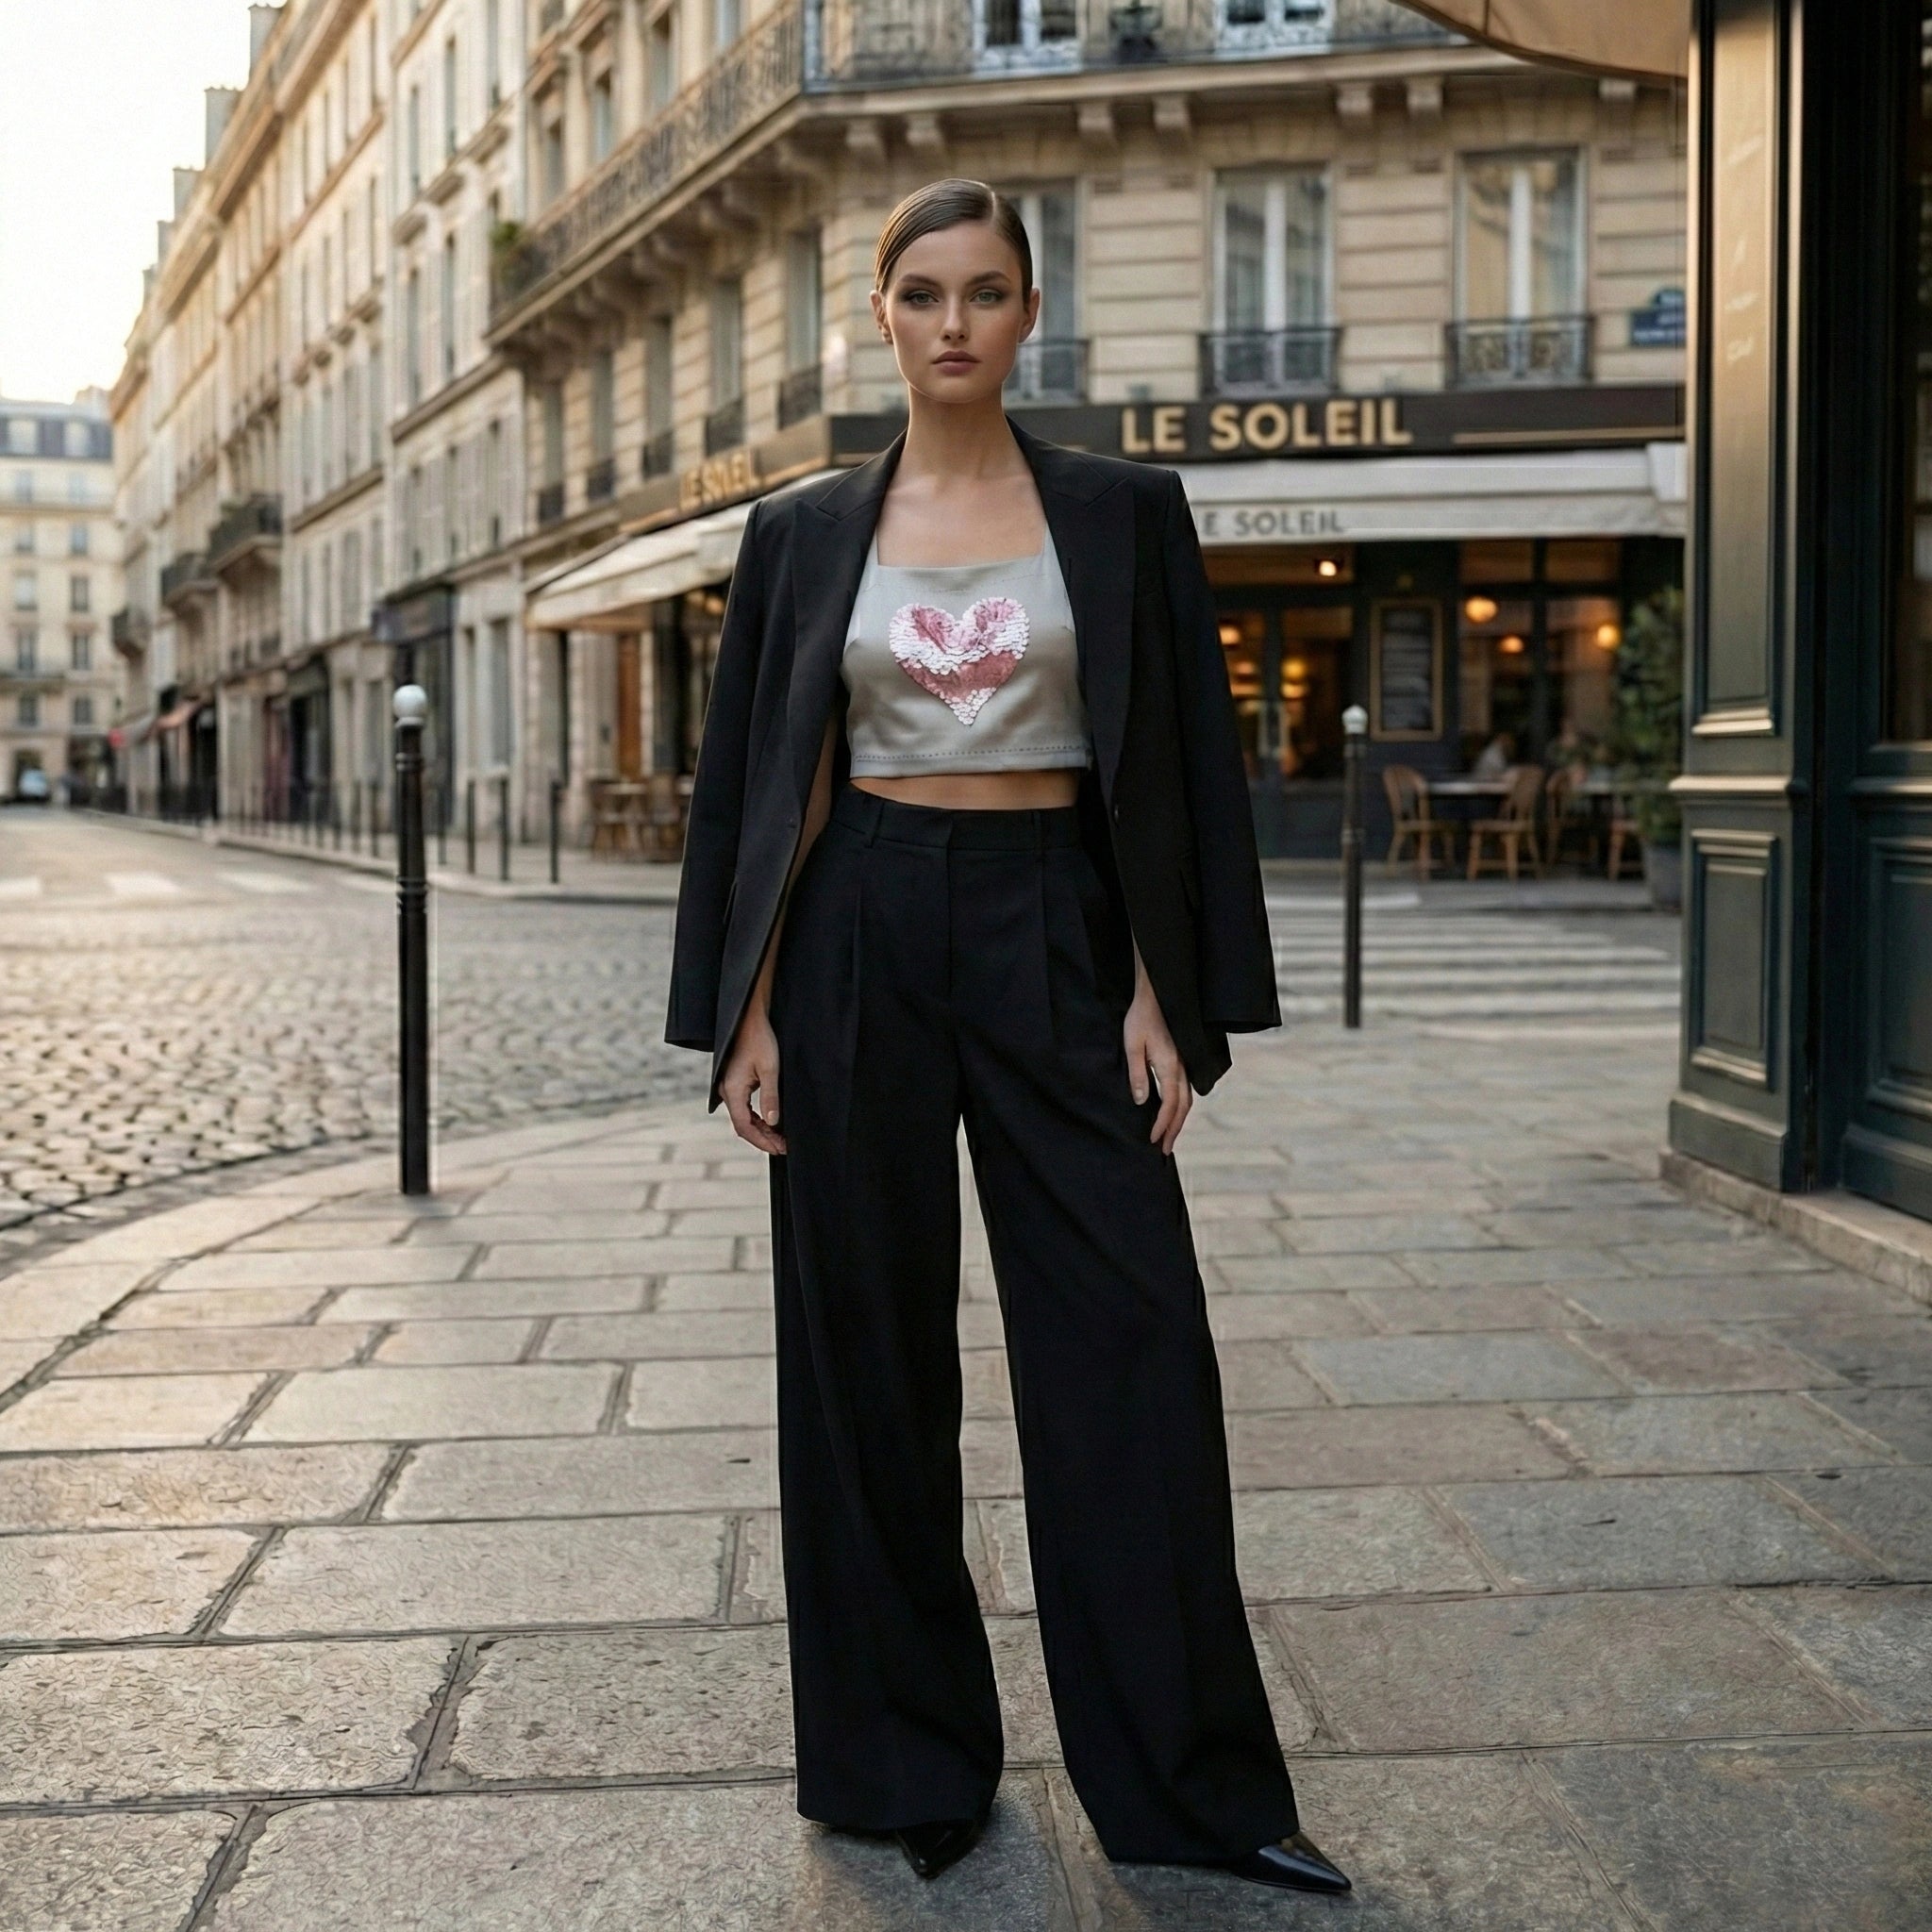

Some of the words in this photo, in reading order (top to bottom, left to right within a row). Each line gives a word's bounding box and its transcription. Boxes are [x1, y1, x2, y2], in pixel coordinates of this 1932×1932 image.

[1122, 407, 1186, 454] LE
[1209, 398, 1412, 451] SOLEIL
[1202, 510, 1219, 537] E
[1234, 508, 1344, 536] SOLEIL
